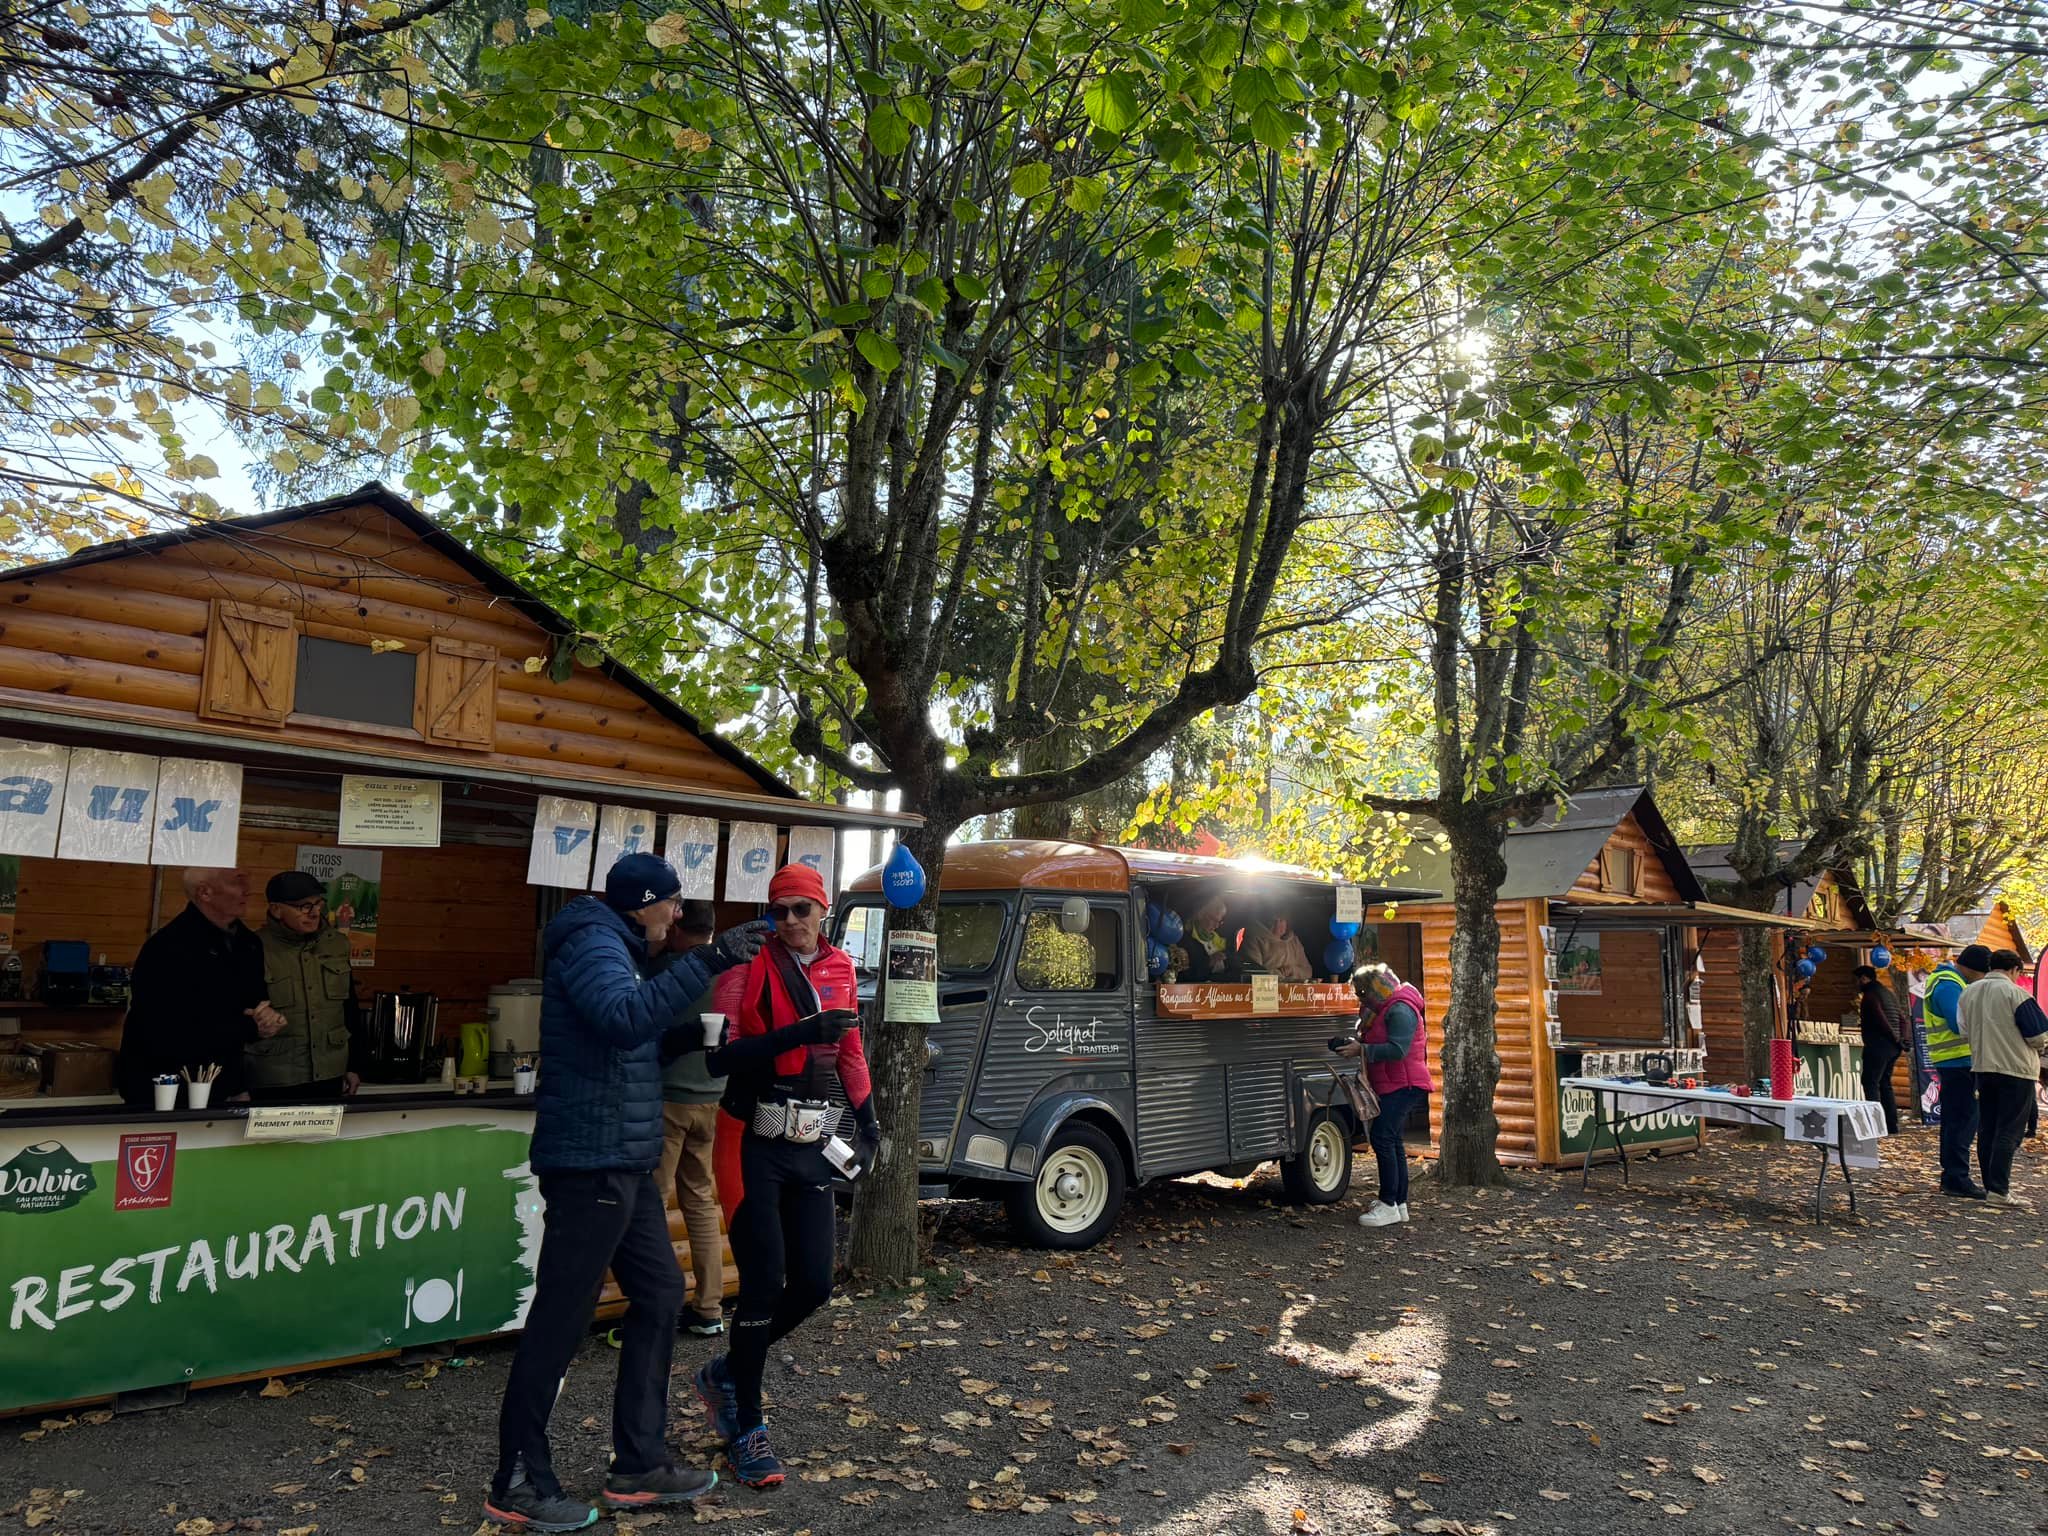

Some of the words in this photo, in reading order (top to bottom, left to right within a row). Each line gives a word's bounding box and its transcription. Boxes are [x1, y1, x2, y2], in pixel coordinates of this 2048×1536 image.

[312, 854, 342, 866] CROSS
[1024, 1005, 1109, 1055] Solignat
[1077, 1044, 1119, 1054] TRAITEUR
[254, 1120, 290, 1128] PAIEMENT
[0, 1167, 87, 1195] Volvic
[9, 1187, 467, 1331] RESTAURATION
